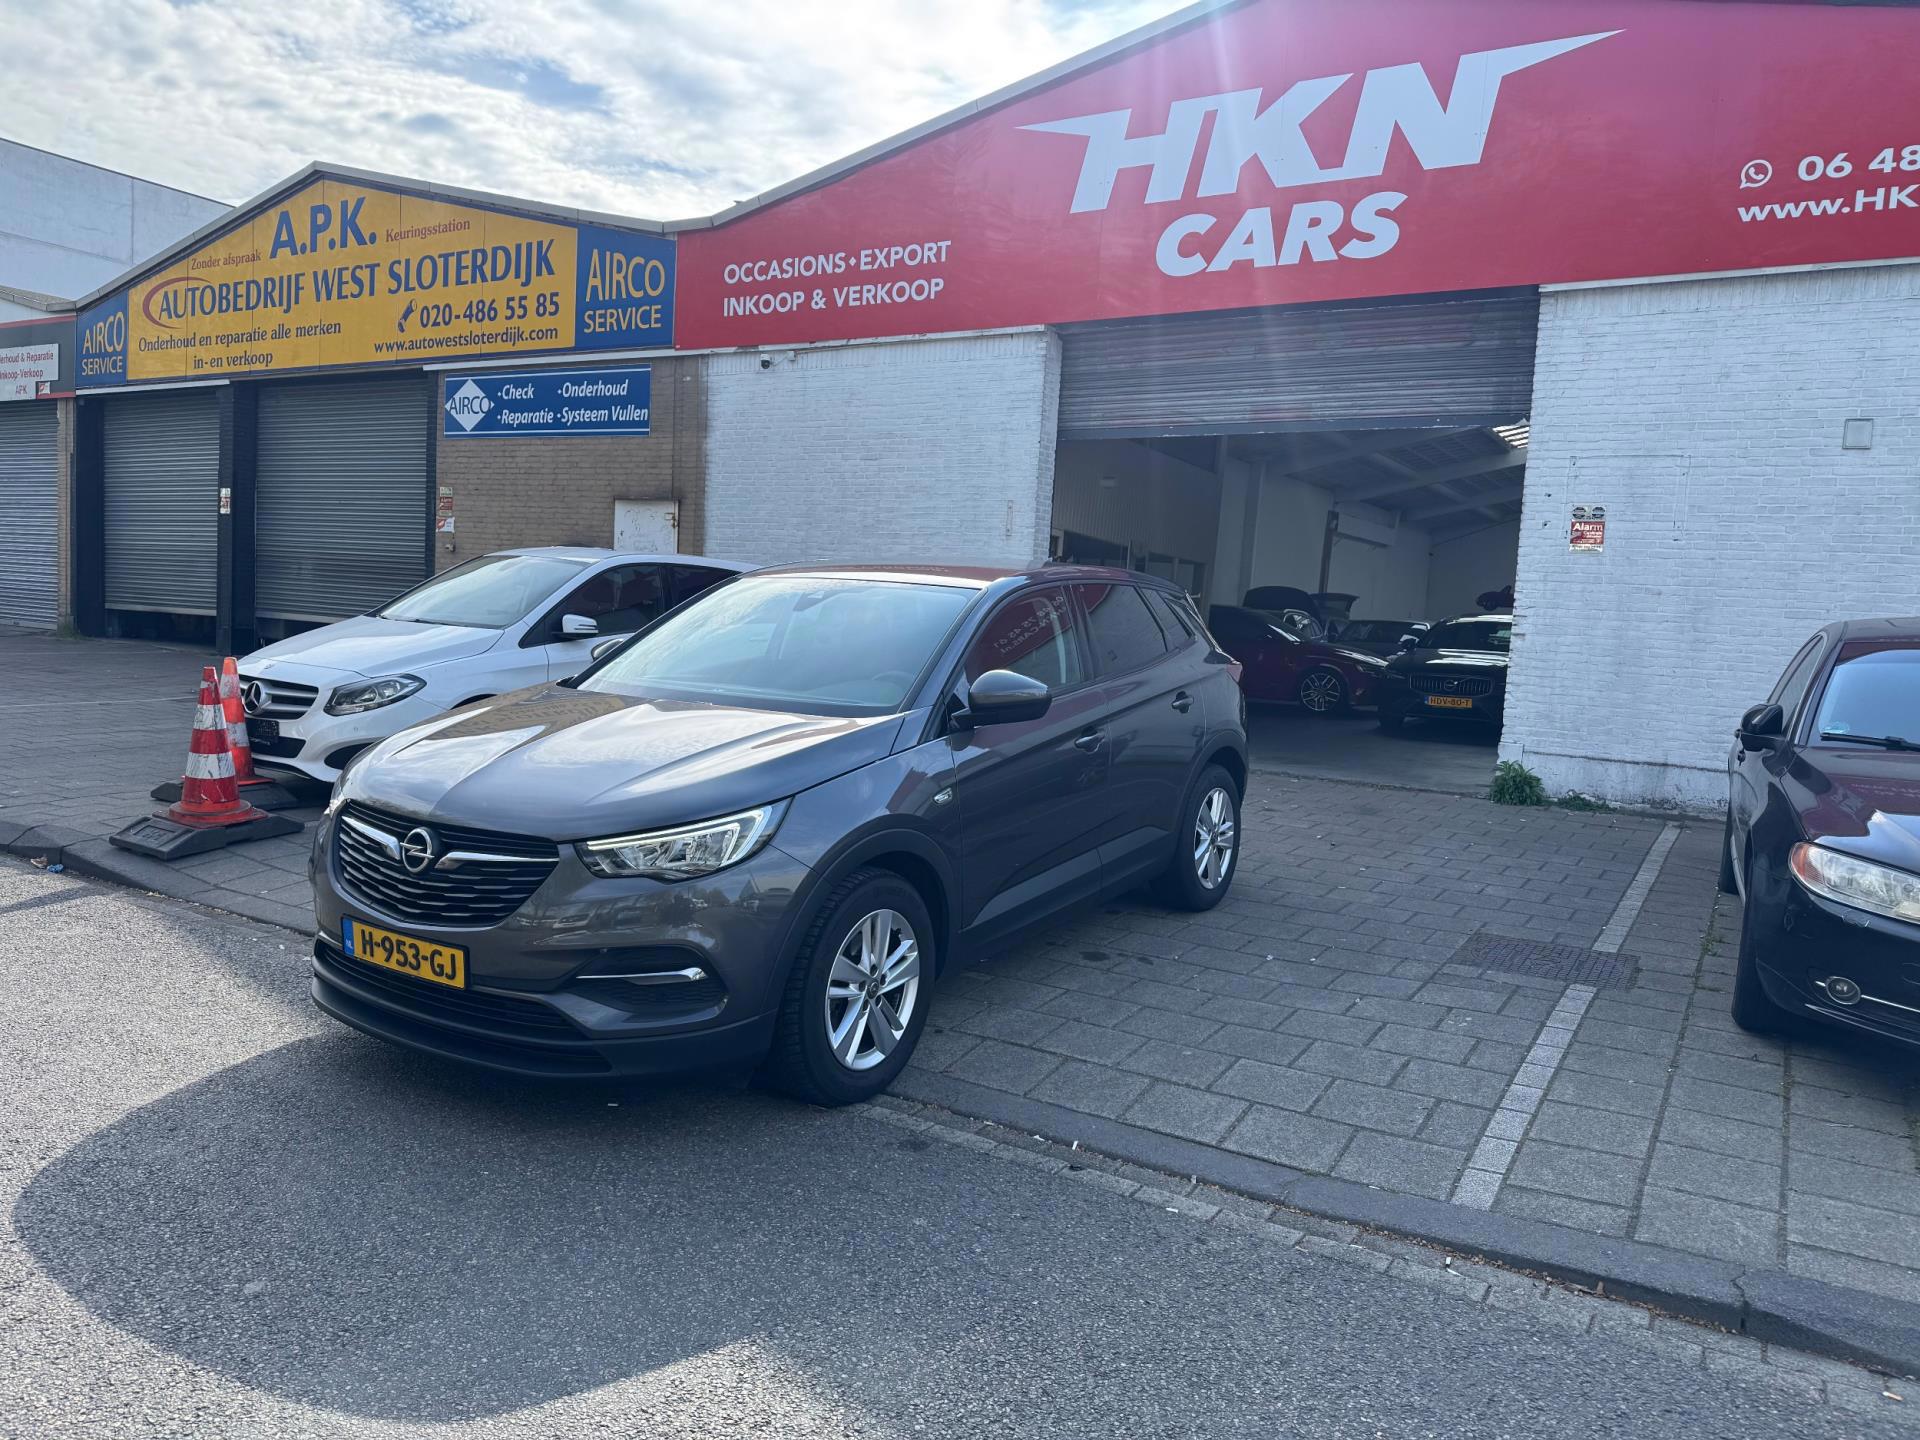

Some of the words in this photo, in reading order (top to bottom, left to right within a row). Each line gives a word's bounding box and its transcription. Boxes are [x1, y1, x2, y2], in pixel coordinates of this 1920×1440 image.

[1013, 29, 1626, 213] HKN
[1797, 152, 1853, 182] 06
[1868, 144, 1920, 173] 48
[1737, 184, 1920, 222] www.HK
[269, 196, 377, 259] A.P.K.
[385, 218, 471, 243] Keuringsstation
[1155, 191, 1408, 277] CARS
[191, 256, 221, 270] Zonder
[223, 249, 261, 267] afspraak
[585, 248, 666, 302] AIRCO
[723, 252, 846, 284] OCCASIONS
[860, 240, 951, 271] EXPORT
[159, 272, 305, 321] AUTOBEDRIJF
[313, 262, 380, 302] WEST
[387, 238, 555, 294] SLOTERDIJK
[419, 298, 498, 329] 020-486
[504, 295, 528, 321] 55
[536, 292, 560, 318] 85
[723, 291, 805, 317] INKOOP
[811, 288, 826, 310] &
[833, 278, 944, 308] VERKOOP
[83, 311, 125, 354] AIRCO
[138, 332, 196, 352] Onderhoud
[199, 335, 212, 346] en
[215, 327, 268, 347] reparatie
[271, 323, 291, 340] alle
[295, 320, 341, 338] merken
[583, 305, 662, 333] SERVICE
[374, 326, 558, 353] www.autowestsloterdijk.com
[26, 350, 54, 364] Reparatie
[81, 356, 123, 376] SERVICE
[226, 350, 273, 368] verkoop
[449, 396, 492, 415] AIRCO
[502, 383, 534, 400] Check
[562, 379, 629, 398] Onderhoud
[501, 408, 554, 427] Reparatie
[560, 406, 608, 426] Systeem
[611, 405, 648, 422] Vullen
[1572, 522, 1603, 531] Alarm
[361, 928, 456, 980] H-953-GJ
